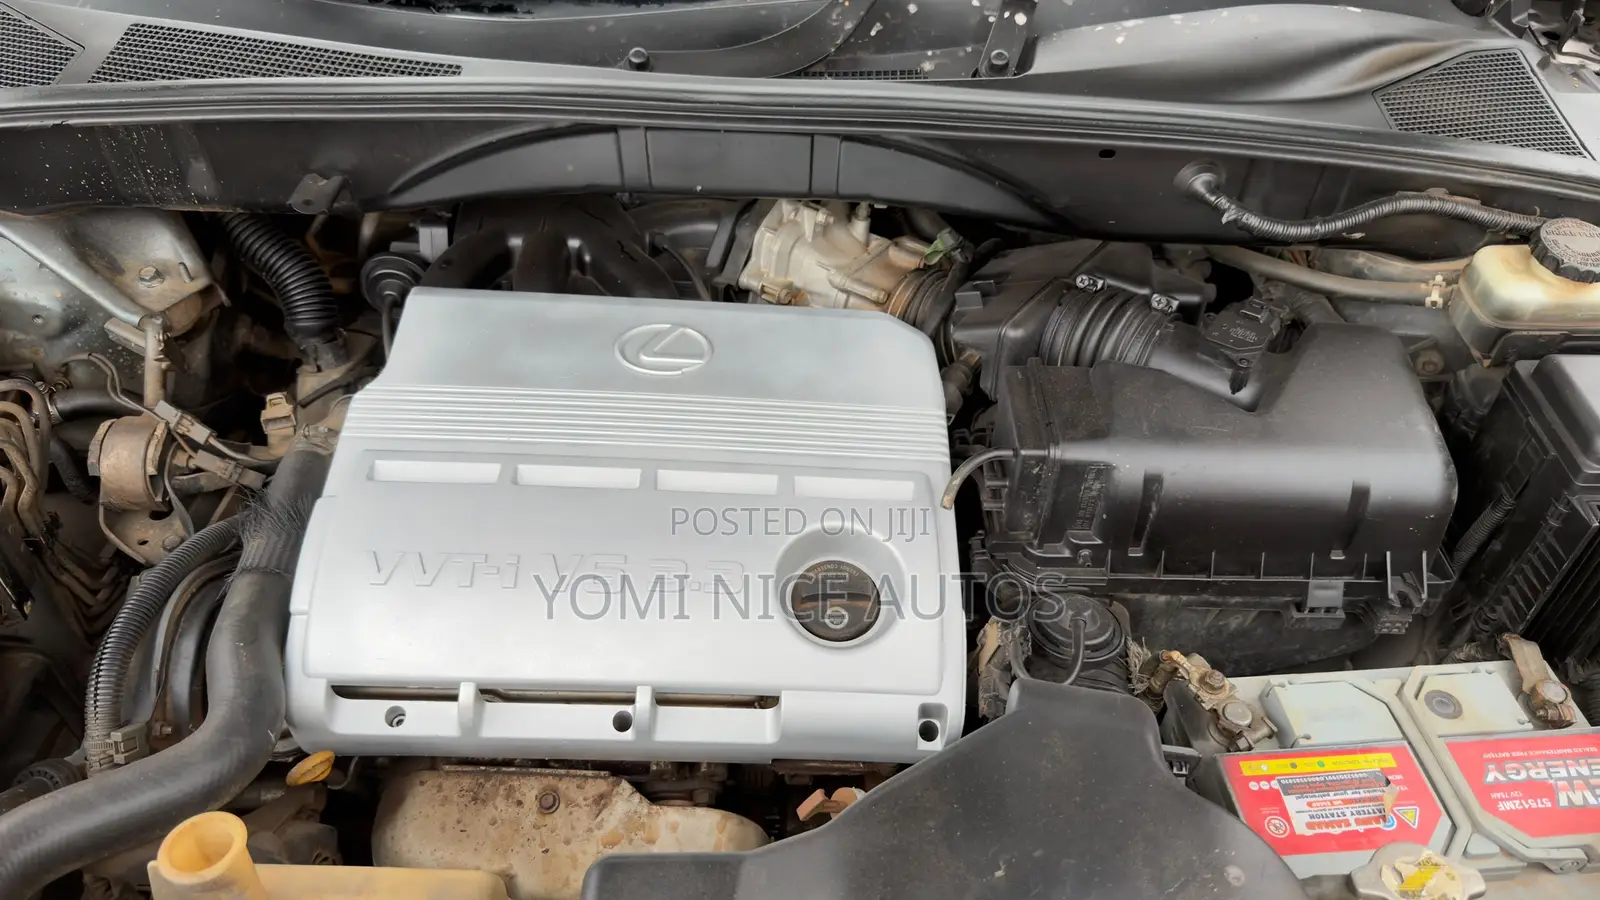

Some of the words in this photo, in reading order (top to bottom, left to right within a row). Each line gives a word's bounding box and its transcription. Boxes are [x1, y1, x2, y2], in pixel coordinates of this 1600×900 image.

[367, 550, 521, 589] VVT-i
[1485, 757, 1600, 783] ENERGY
[1497, 798, 1552, 811] 57512MF
[1308, 812, 1347, 820] STATION
